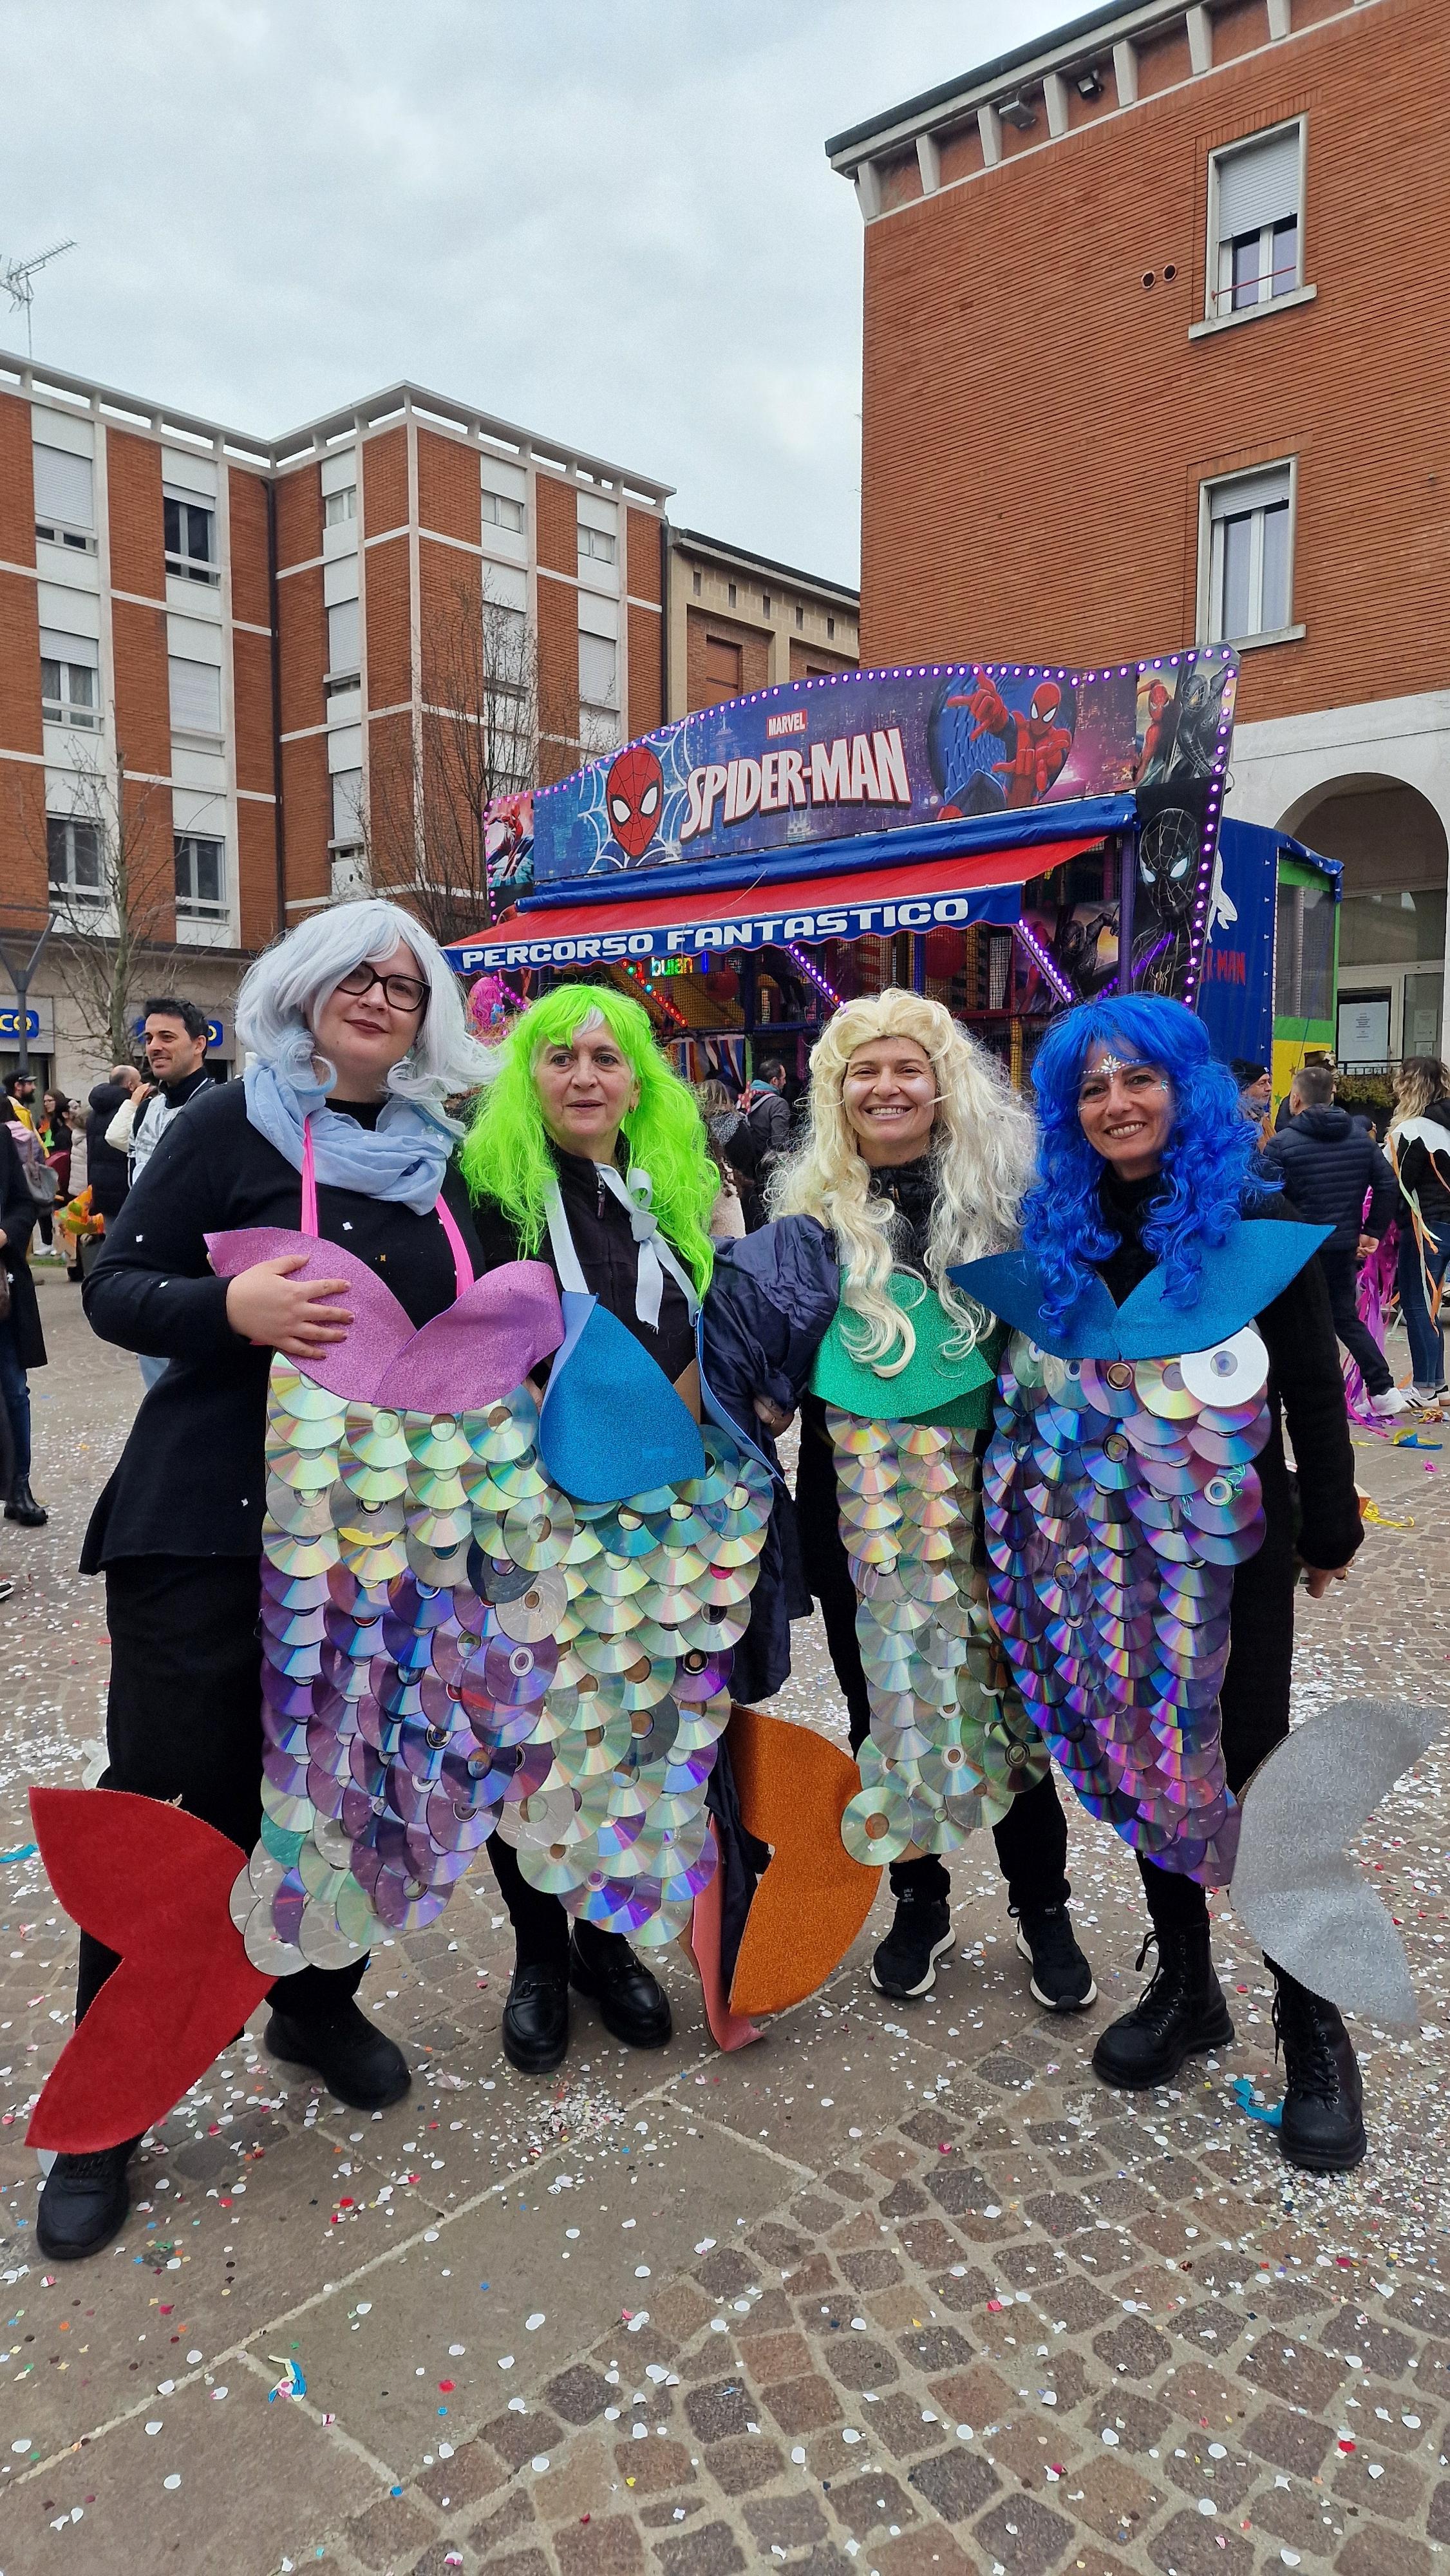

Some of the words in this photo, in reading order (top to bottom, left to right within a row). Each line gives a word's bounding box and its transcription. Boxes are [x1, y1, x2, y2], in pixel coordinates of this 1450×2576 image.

[767, 712, 805, 737] MARVEL
[680, 727, 912, 841] SPIDER-MAN
[462, 934, 654, 969] PERCORSO
[667, 898, 968, 951] FANTASTICO
